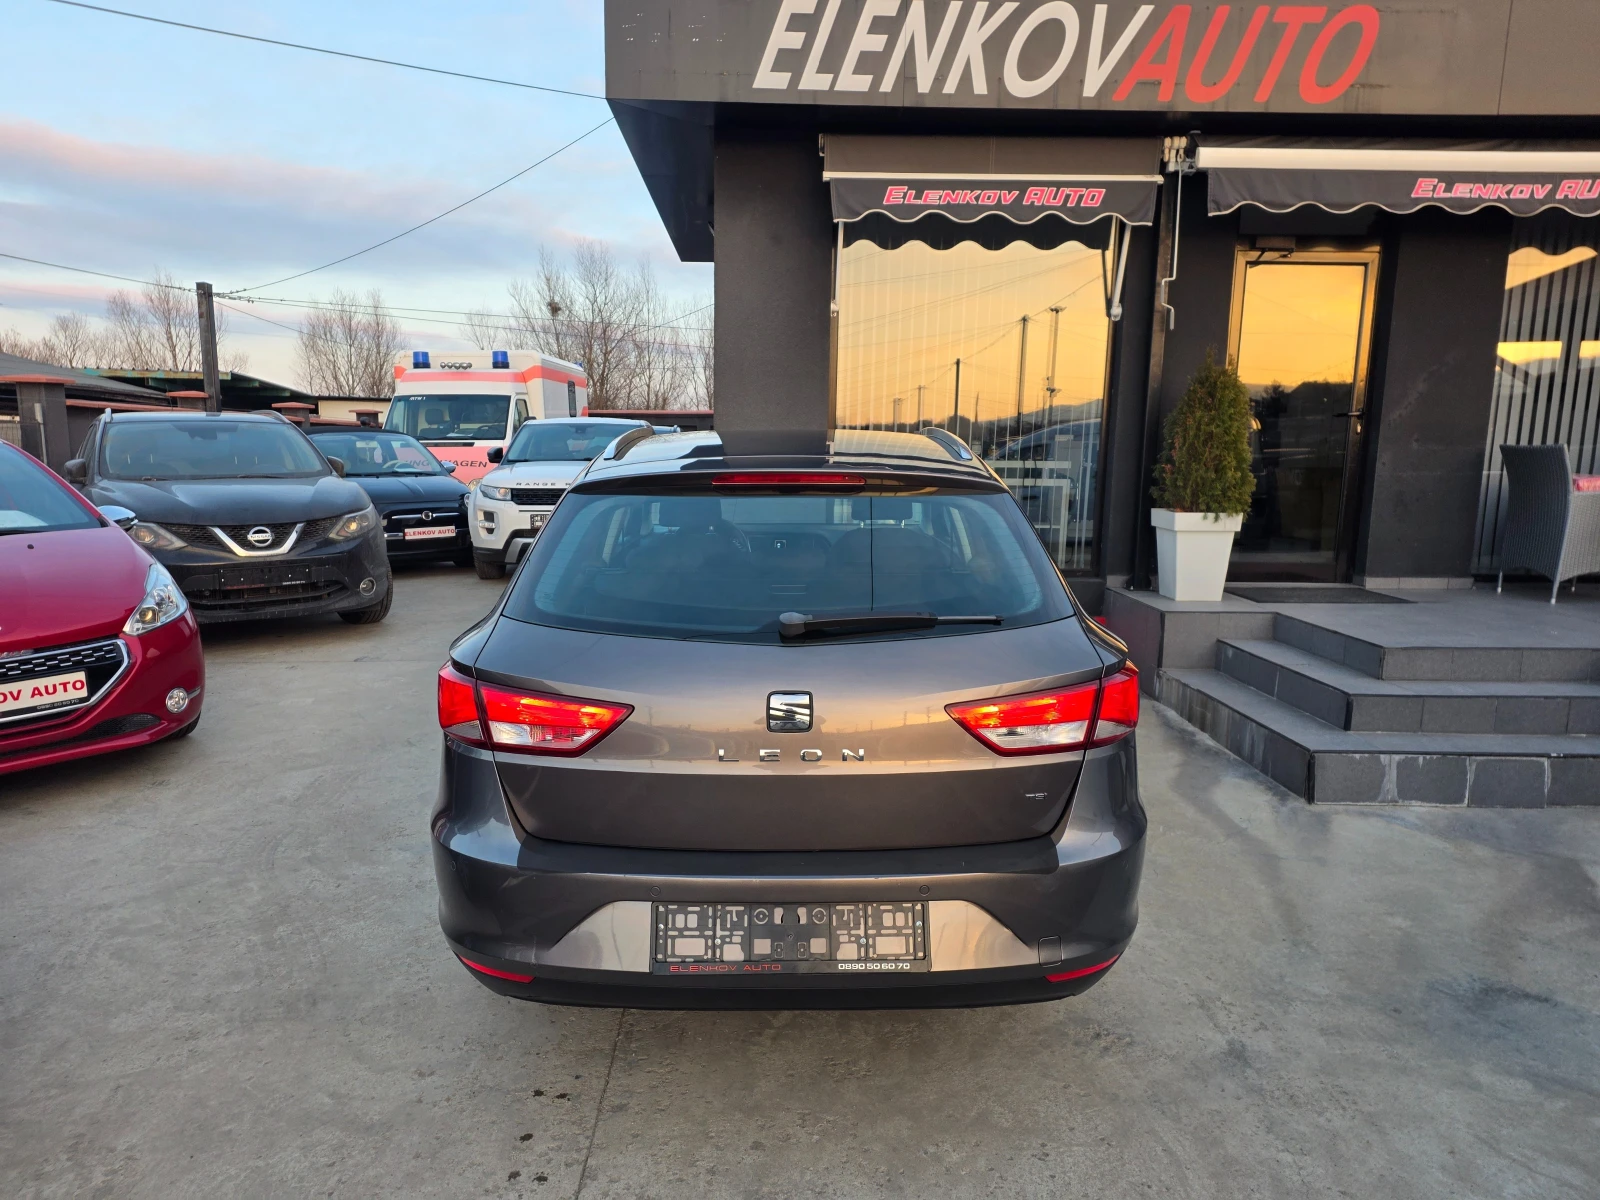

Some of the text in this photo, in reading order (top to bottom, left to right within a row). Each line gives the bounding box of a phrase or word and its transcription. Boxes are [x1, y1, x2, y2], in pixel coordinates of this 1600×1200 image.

[883, 186, 1106, 207] ELENKOV AUTO
[1411, 178, 1552, 199] ELENKOV
[404, 529, 436, 537] ELENKOV
[30, 679, 86, 699] AUTO
[719, 749, 864, 761] LEON
[881, 962, 895, 970] 60
[896, 962, 910, 970] 70
